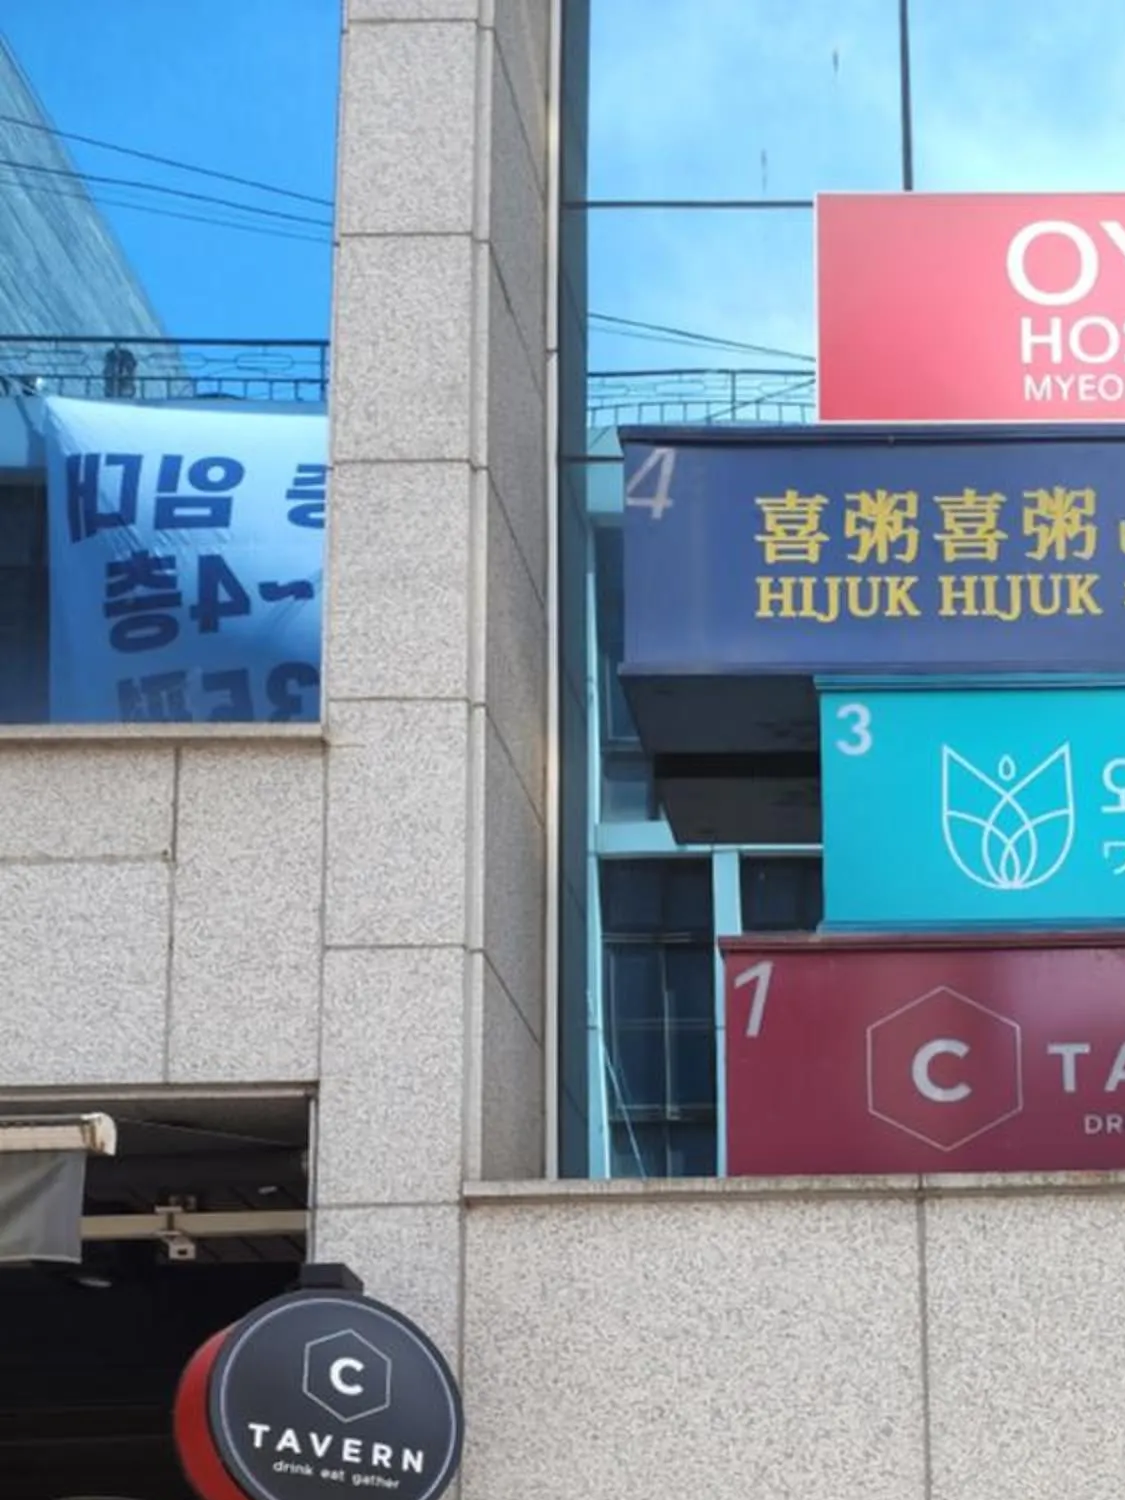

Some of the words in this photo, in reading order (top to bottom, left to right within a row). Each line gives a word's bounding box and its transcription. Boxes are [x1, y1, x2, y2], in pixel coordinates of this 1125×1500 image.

[626, 447, 676, 520] 4
[754, 486, 1098, 566] 喜粥喜粥
[755, 577, 921, 620] HIJUK
[938, 576, 1105, 620] HIJUK
[836, 703, 874, 756] 3
[733, 959, 775, 1038] 1
[911, 1038, 972, 1103] C
[329, 1357, 364, 1395] C
[248, 1422, 425, 1474] TAVERN
[273, 1459, 314, 1478] drink
[320, 1468, 345, 1483] eat
[352, 1472, 400, 1490] gather
